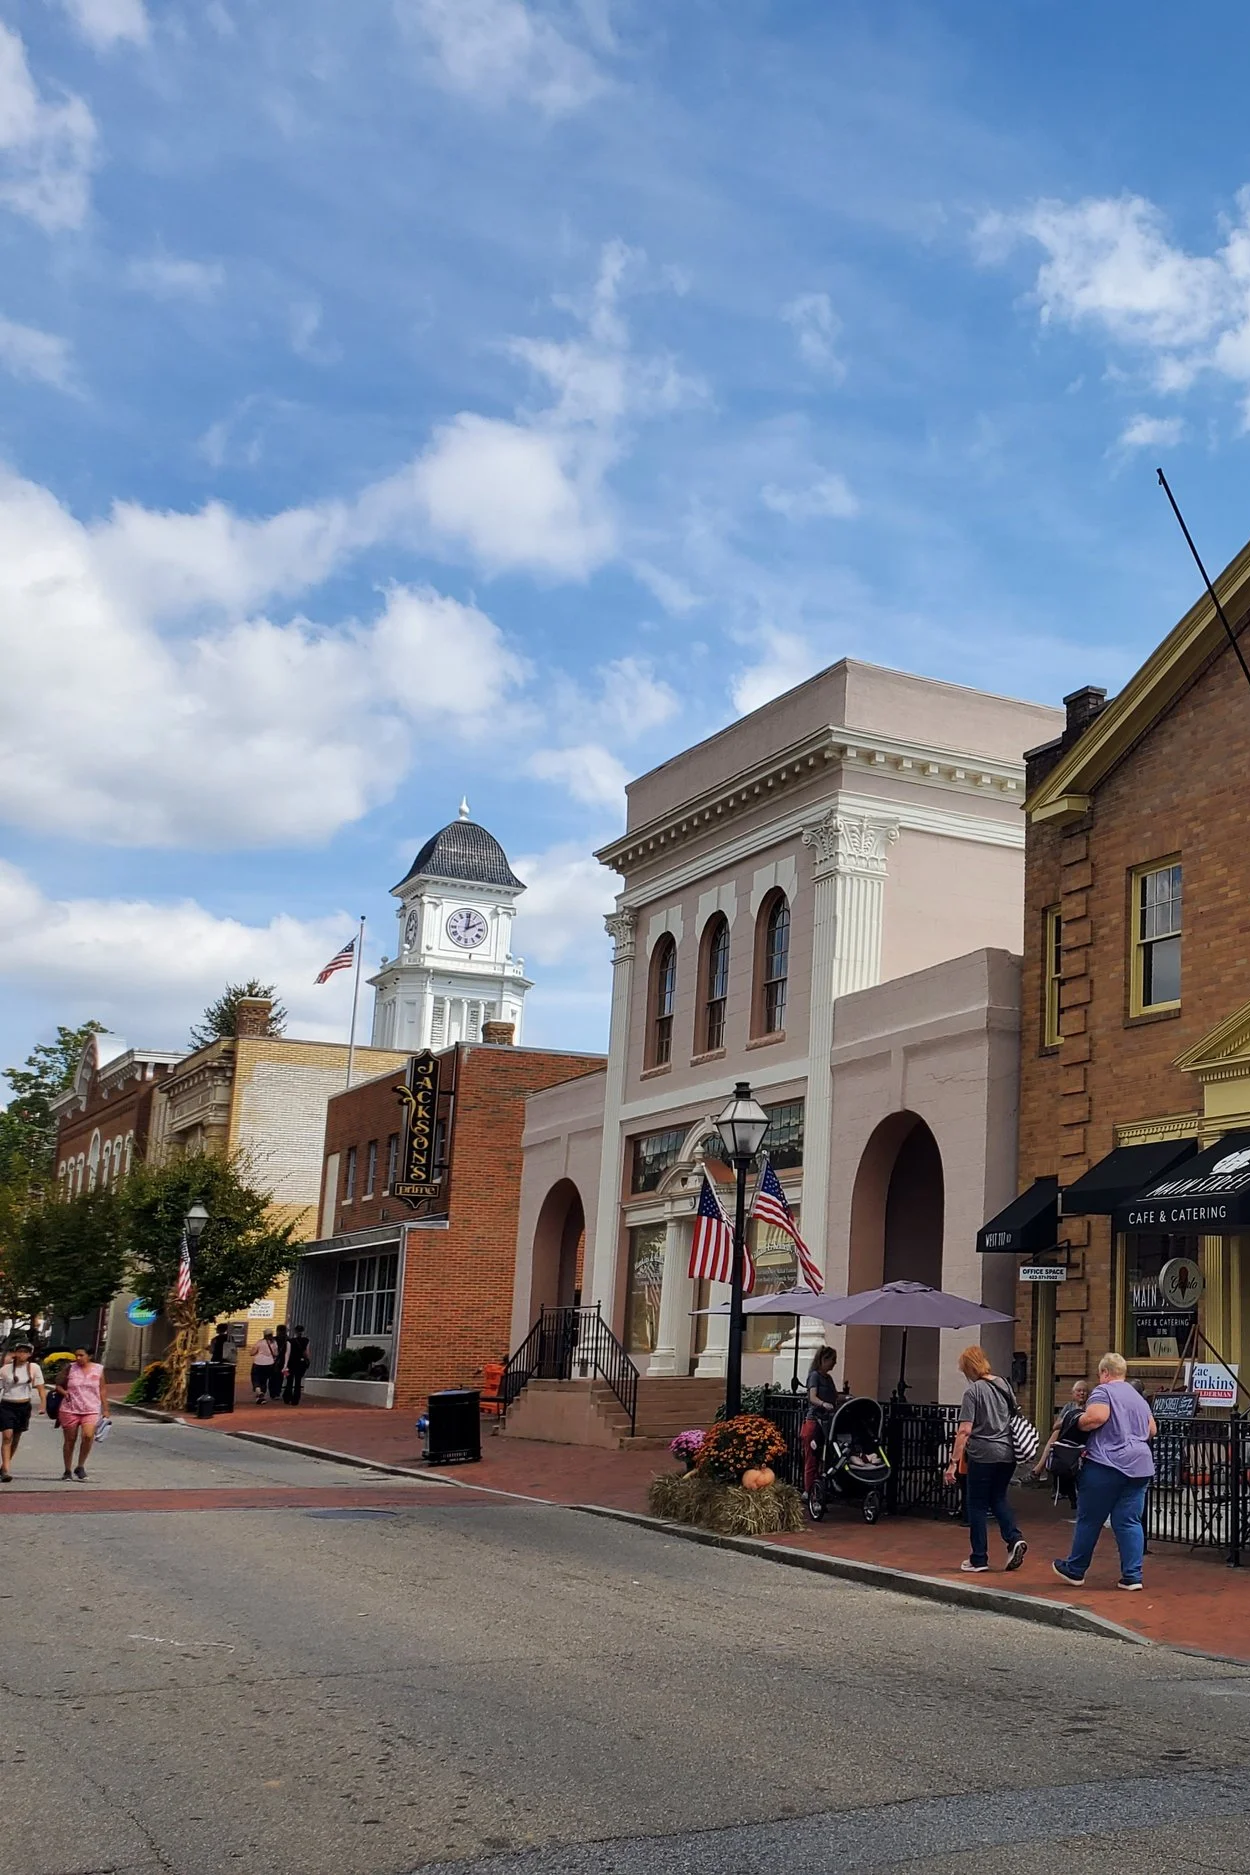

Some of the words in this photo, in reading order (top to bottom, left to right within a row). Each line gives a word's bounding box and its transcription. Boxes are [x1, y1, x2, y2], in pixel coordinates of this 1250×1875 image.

[410, 1060, 434, 1181] JACKSON'S
[399, 1185, 436, 1196] prime
[1146, 1177, 1203, 1197] MAIN
[1128, 1210, 1155, 1225] CAFE
[1159, 1210, 1167, 1223] &
[1171, 1205, 1227, 1222] CATERING
[985, 1232, 998, 1248] WEST
[1132, 1284, 1157, 1308] MAIN
[1136, 1318, 1151, 1327] CAFE
[1152, 1318, 1157, 1327] &
[1159, 1318, 1190, 1327] CATERING
[1194, 1375, 1235, 1390] enkins
[1199, 1390, 1233, 1398] LDERMAN
